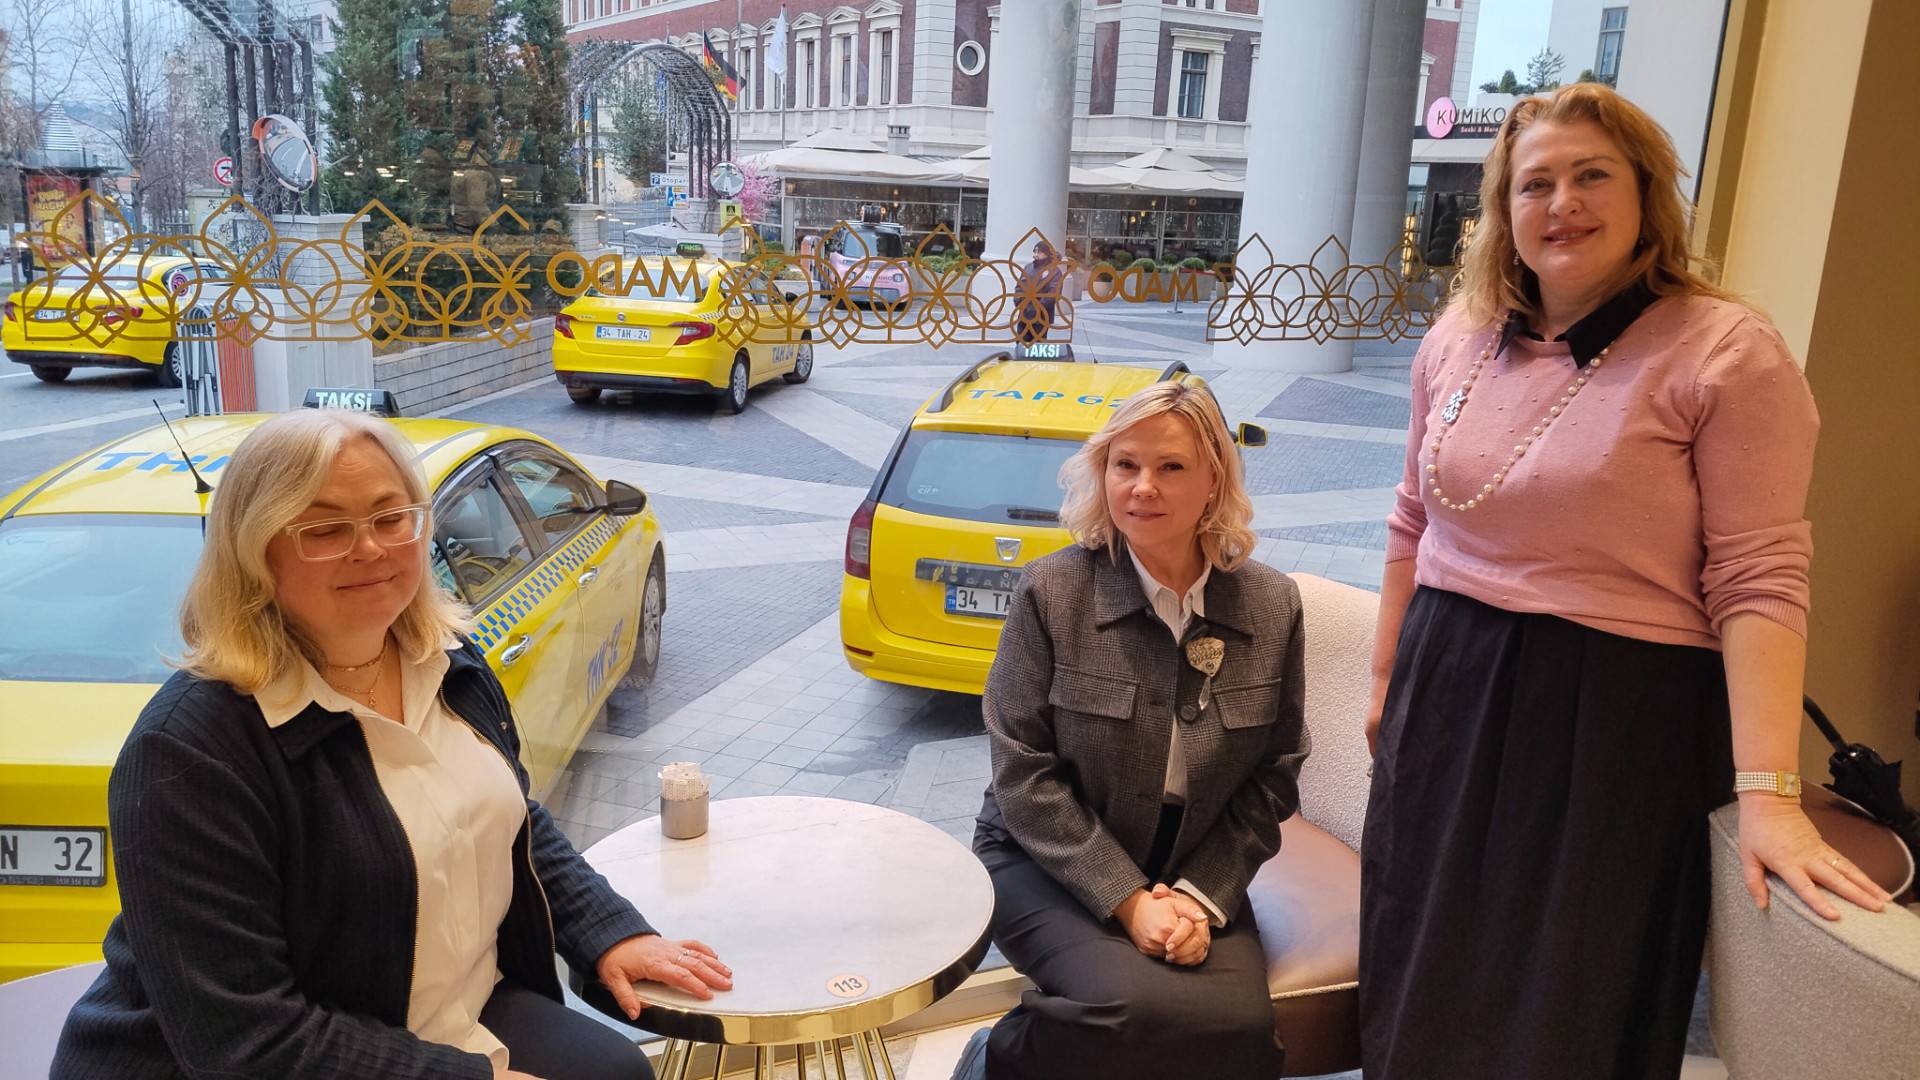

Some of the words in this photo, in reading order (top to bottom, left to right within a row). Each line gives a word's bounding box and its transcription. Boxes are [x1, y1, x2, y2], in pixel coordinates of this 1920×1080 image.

[1437, 107, 1506, 125] KUMiKO
[602, 328, 611, 337] 34
[617, 328, 632, 338] TAH
[638, 331, 648, 340] 24
[1023, 344, 1060, 358] TAKSi
[316, 391, 373, 411] TAKSi
[969, 389, 1065, 401] TAP
[958, 590, 978, 610] 34
[0, 835, 18, 870] N
[54, 836, 93, 872] 32
[834, 978, 862, 992] 113
